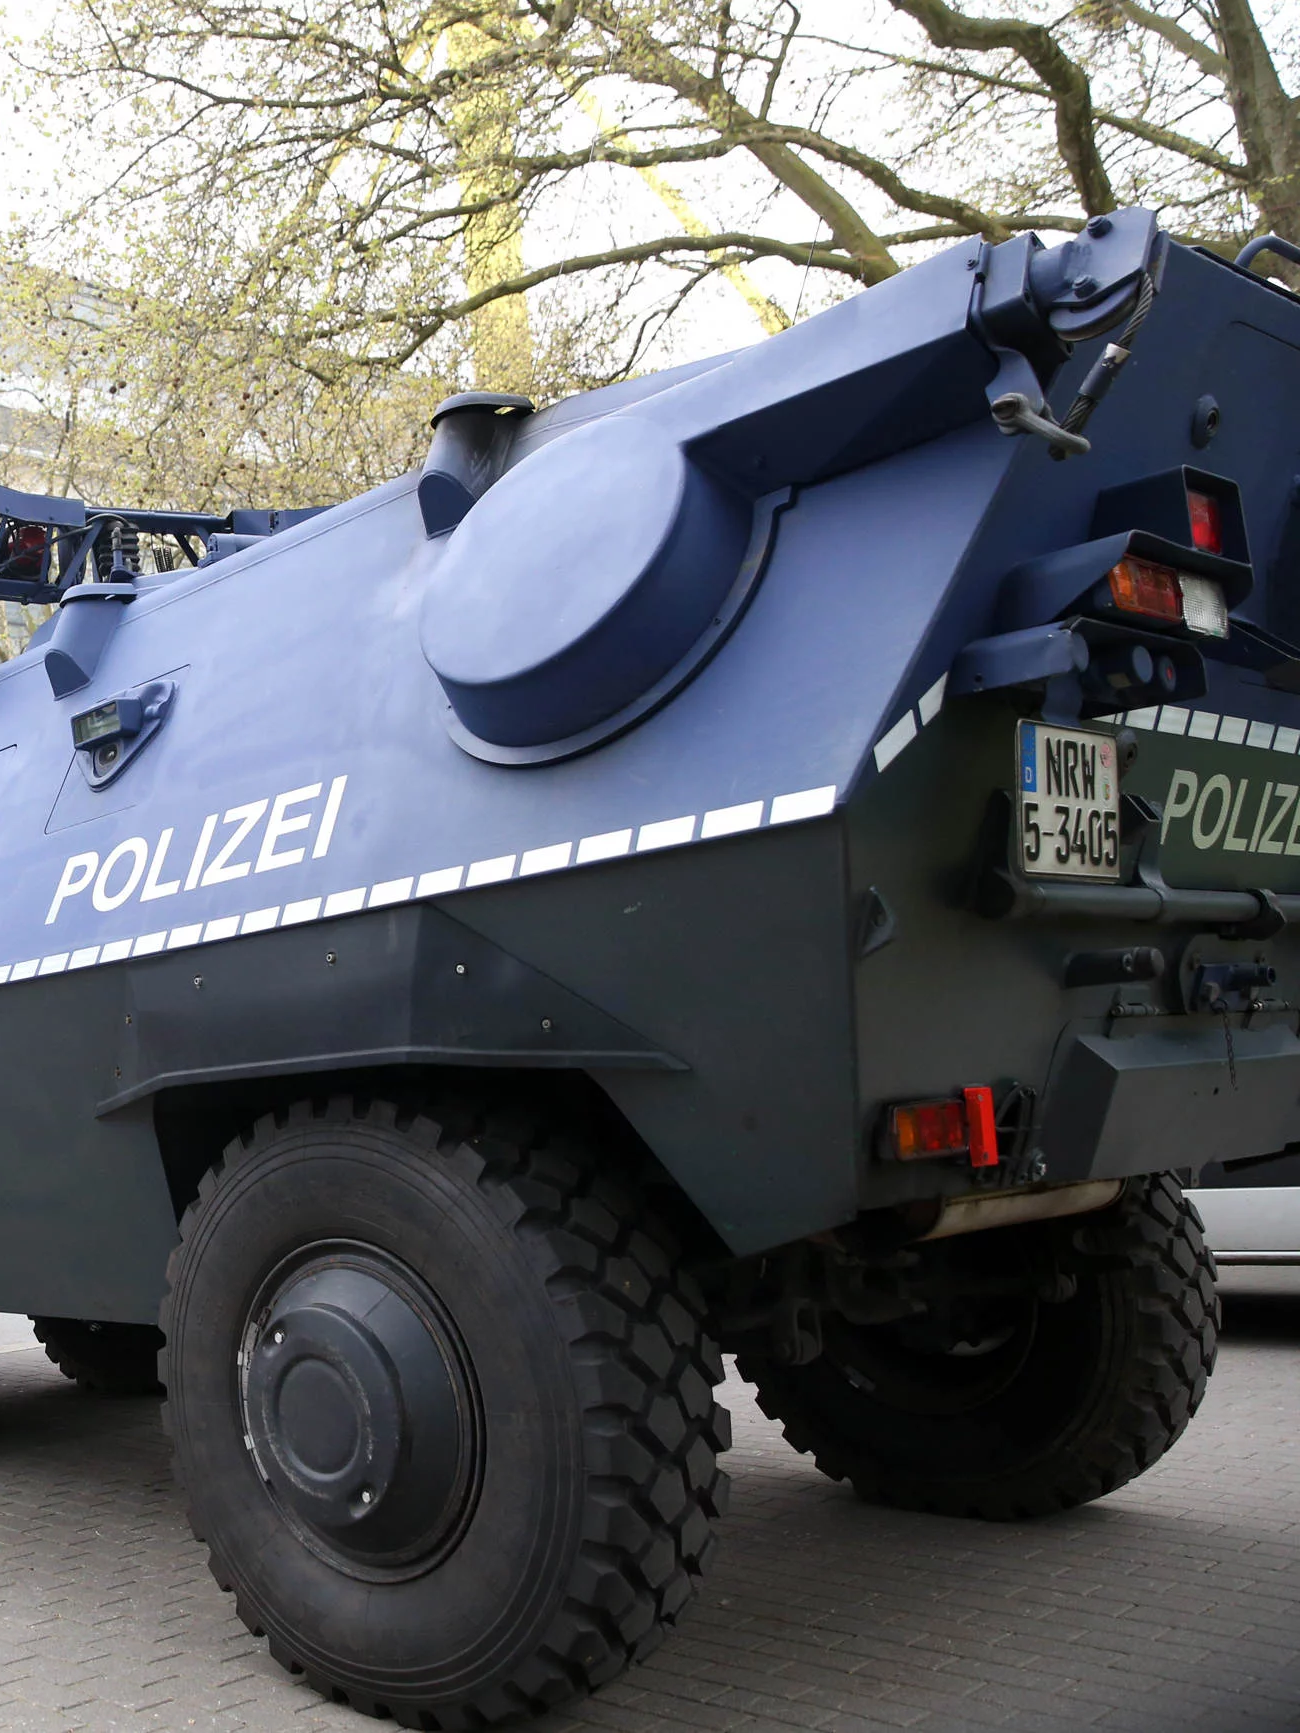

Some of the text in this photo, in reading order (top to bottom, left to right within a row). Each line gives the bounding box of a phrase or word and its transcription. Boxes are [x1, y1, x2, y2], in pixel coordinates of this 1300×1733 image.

[1025, 767, 1032, 783] D
[1045, 737, 1095, 800] NRW
[44, 775, 348, 925] POLIZEI
[1024, 801, 1118, 867] 5-3405
